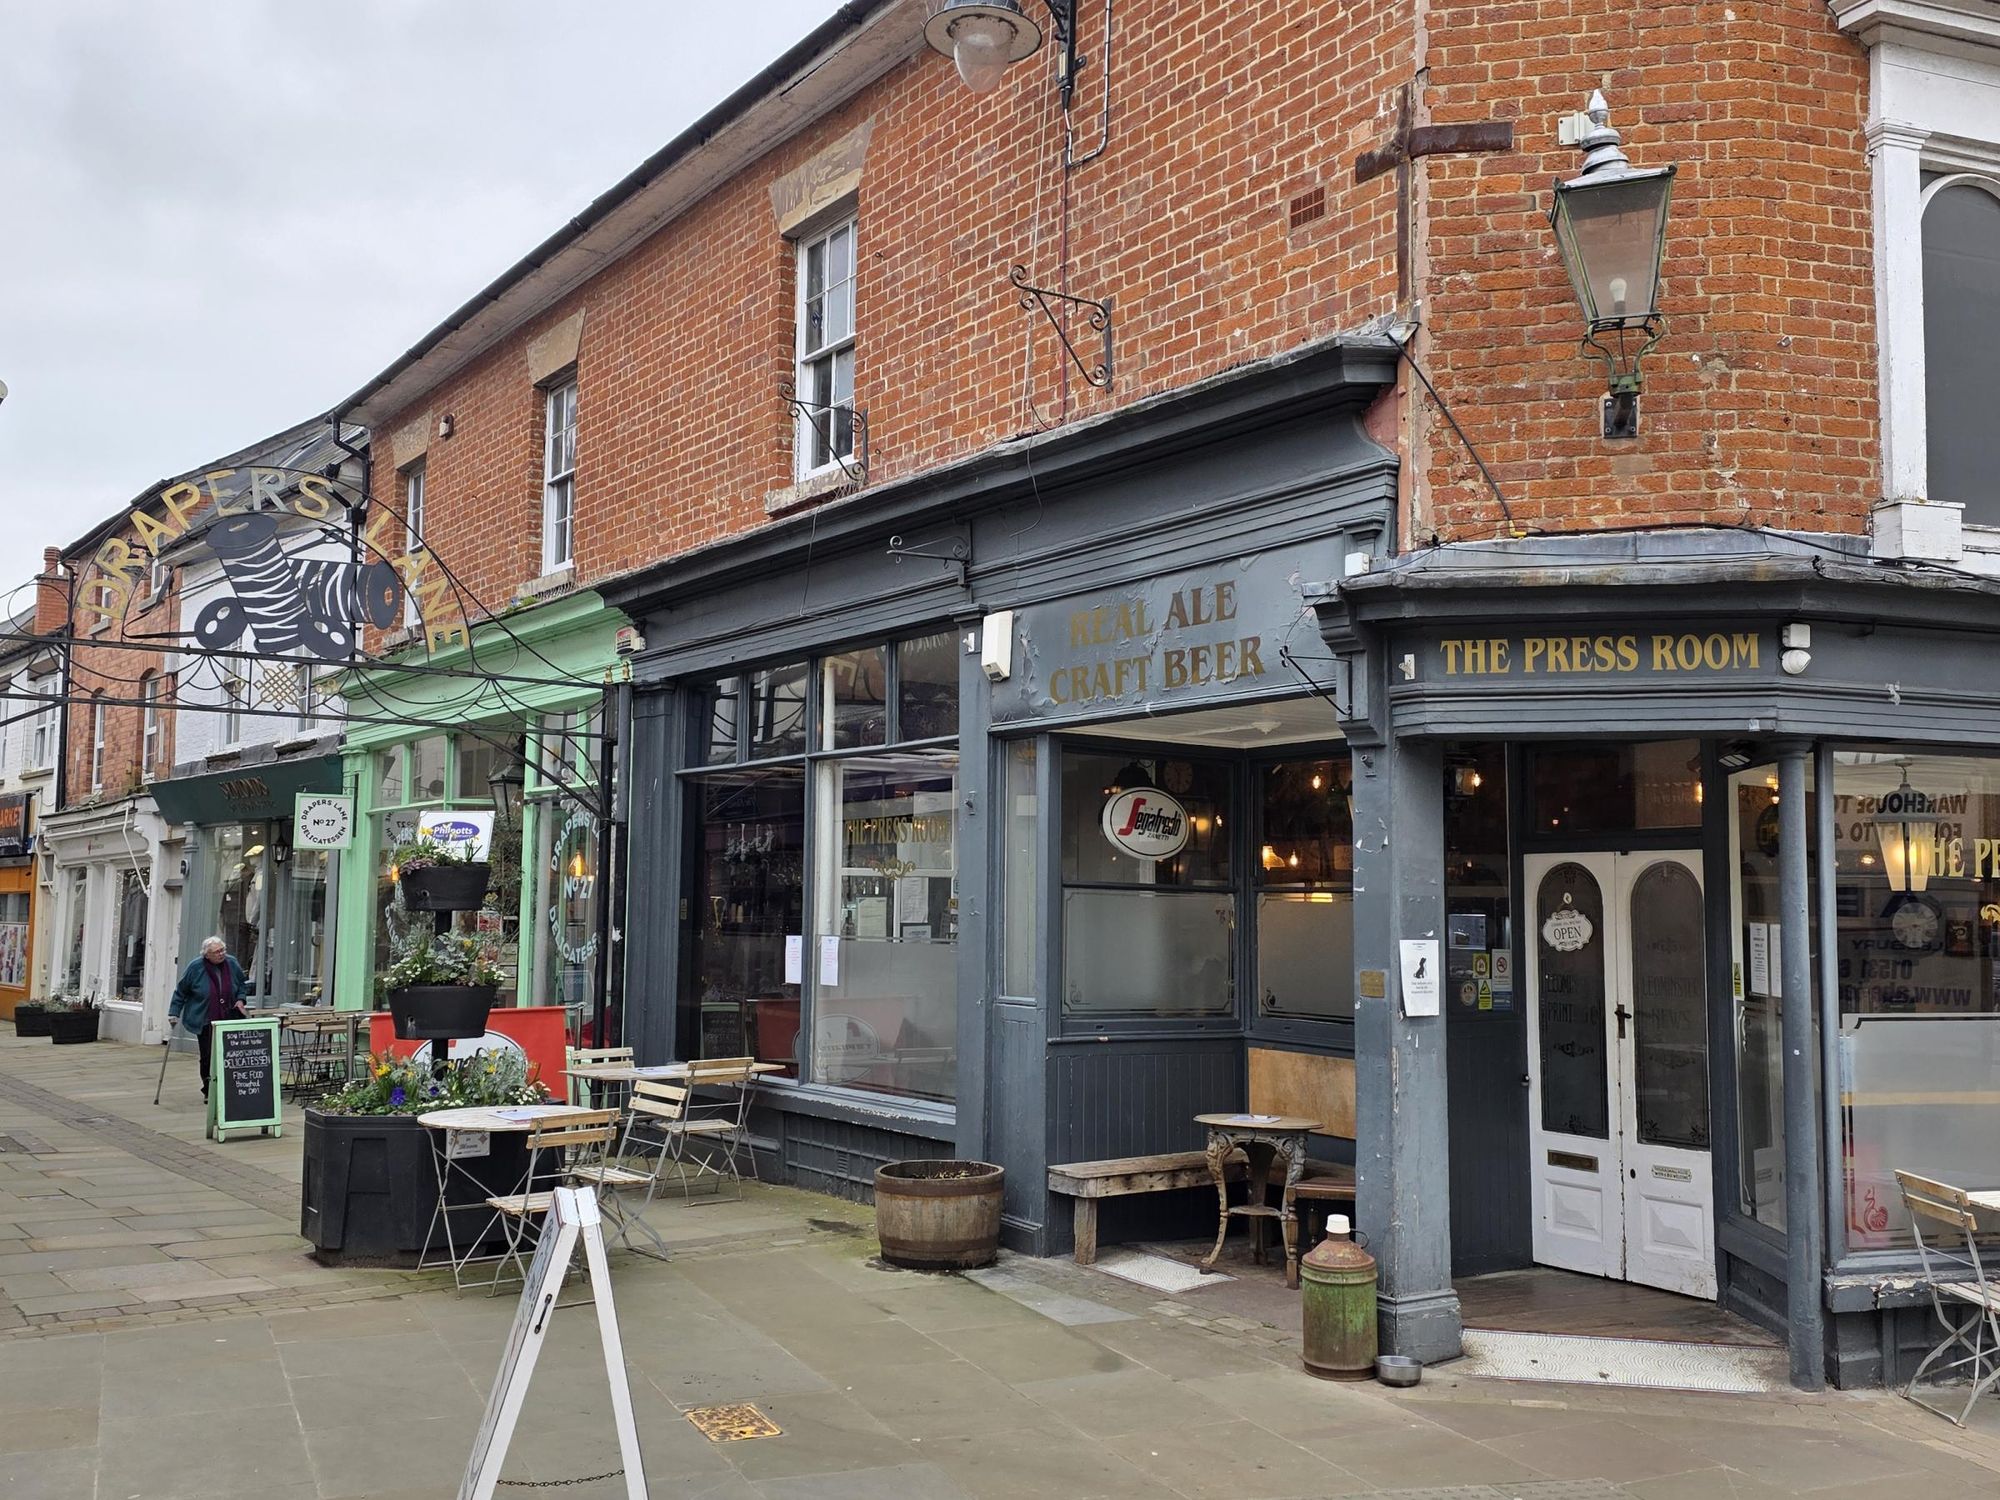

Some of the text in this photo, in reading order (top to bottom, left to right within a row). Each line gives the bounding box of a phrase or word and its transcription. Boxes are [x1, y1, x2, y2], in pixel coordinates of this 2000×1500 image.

[78, 468, 469, 654] DRAPERS LANE
[1070, 579, 1238, 647] REAL ALE
[1440, 633, 1761, 675] THE PRESS ROOM
[1050, 635, 1266, 705] CRAFT BEER
[301, 799, 348, 820] DRAPERS LANE
[1117, 797, 1182, 837] Segafredo
[301, 824, 347, 845] DELICATESSEN
[550, 811, 591, 872] DRAPERS
[870, 816, 908, 844] PRESS
[580, 877, 594, 899] 27
[1553, 926, 1582, 941] OPEN
[239, 1030, 257, 1039] HELLO
[224, 1056, 270, 1068] DELICATESSEN
[232, 1070, 264, 1080] FINE FOOD
